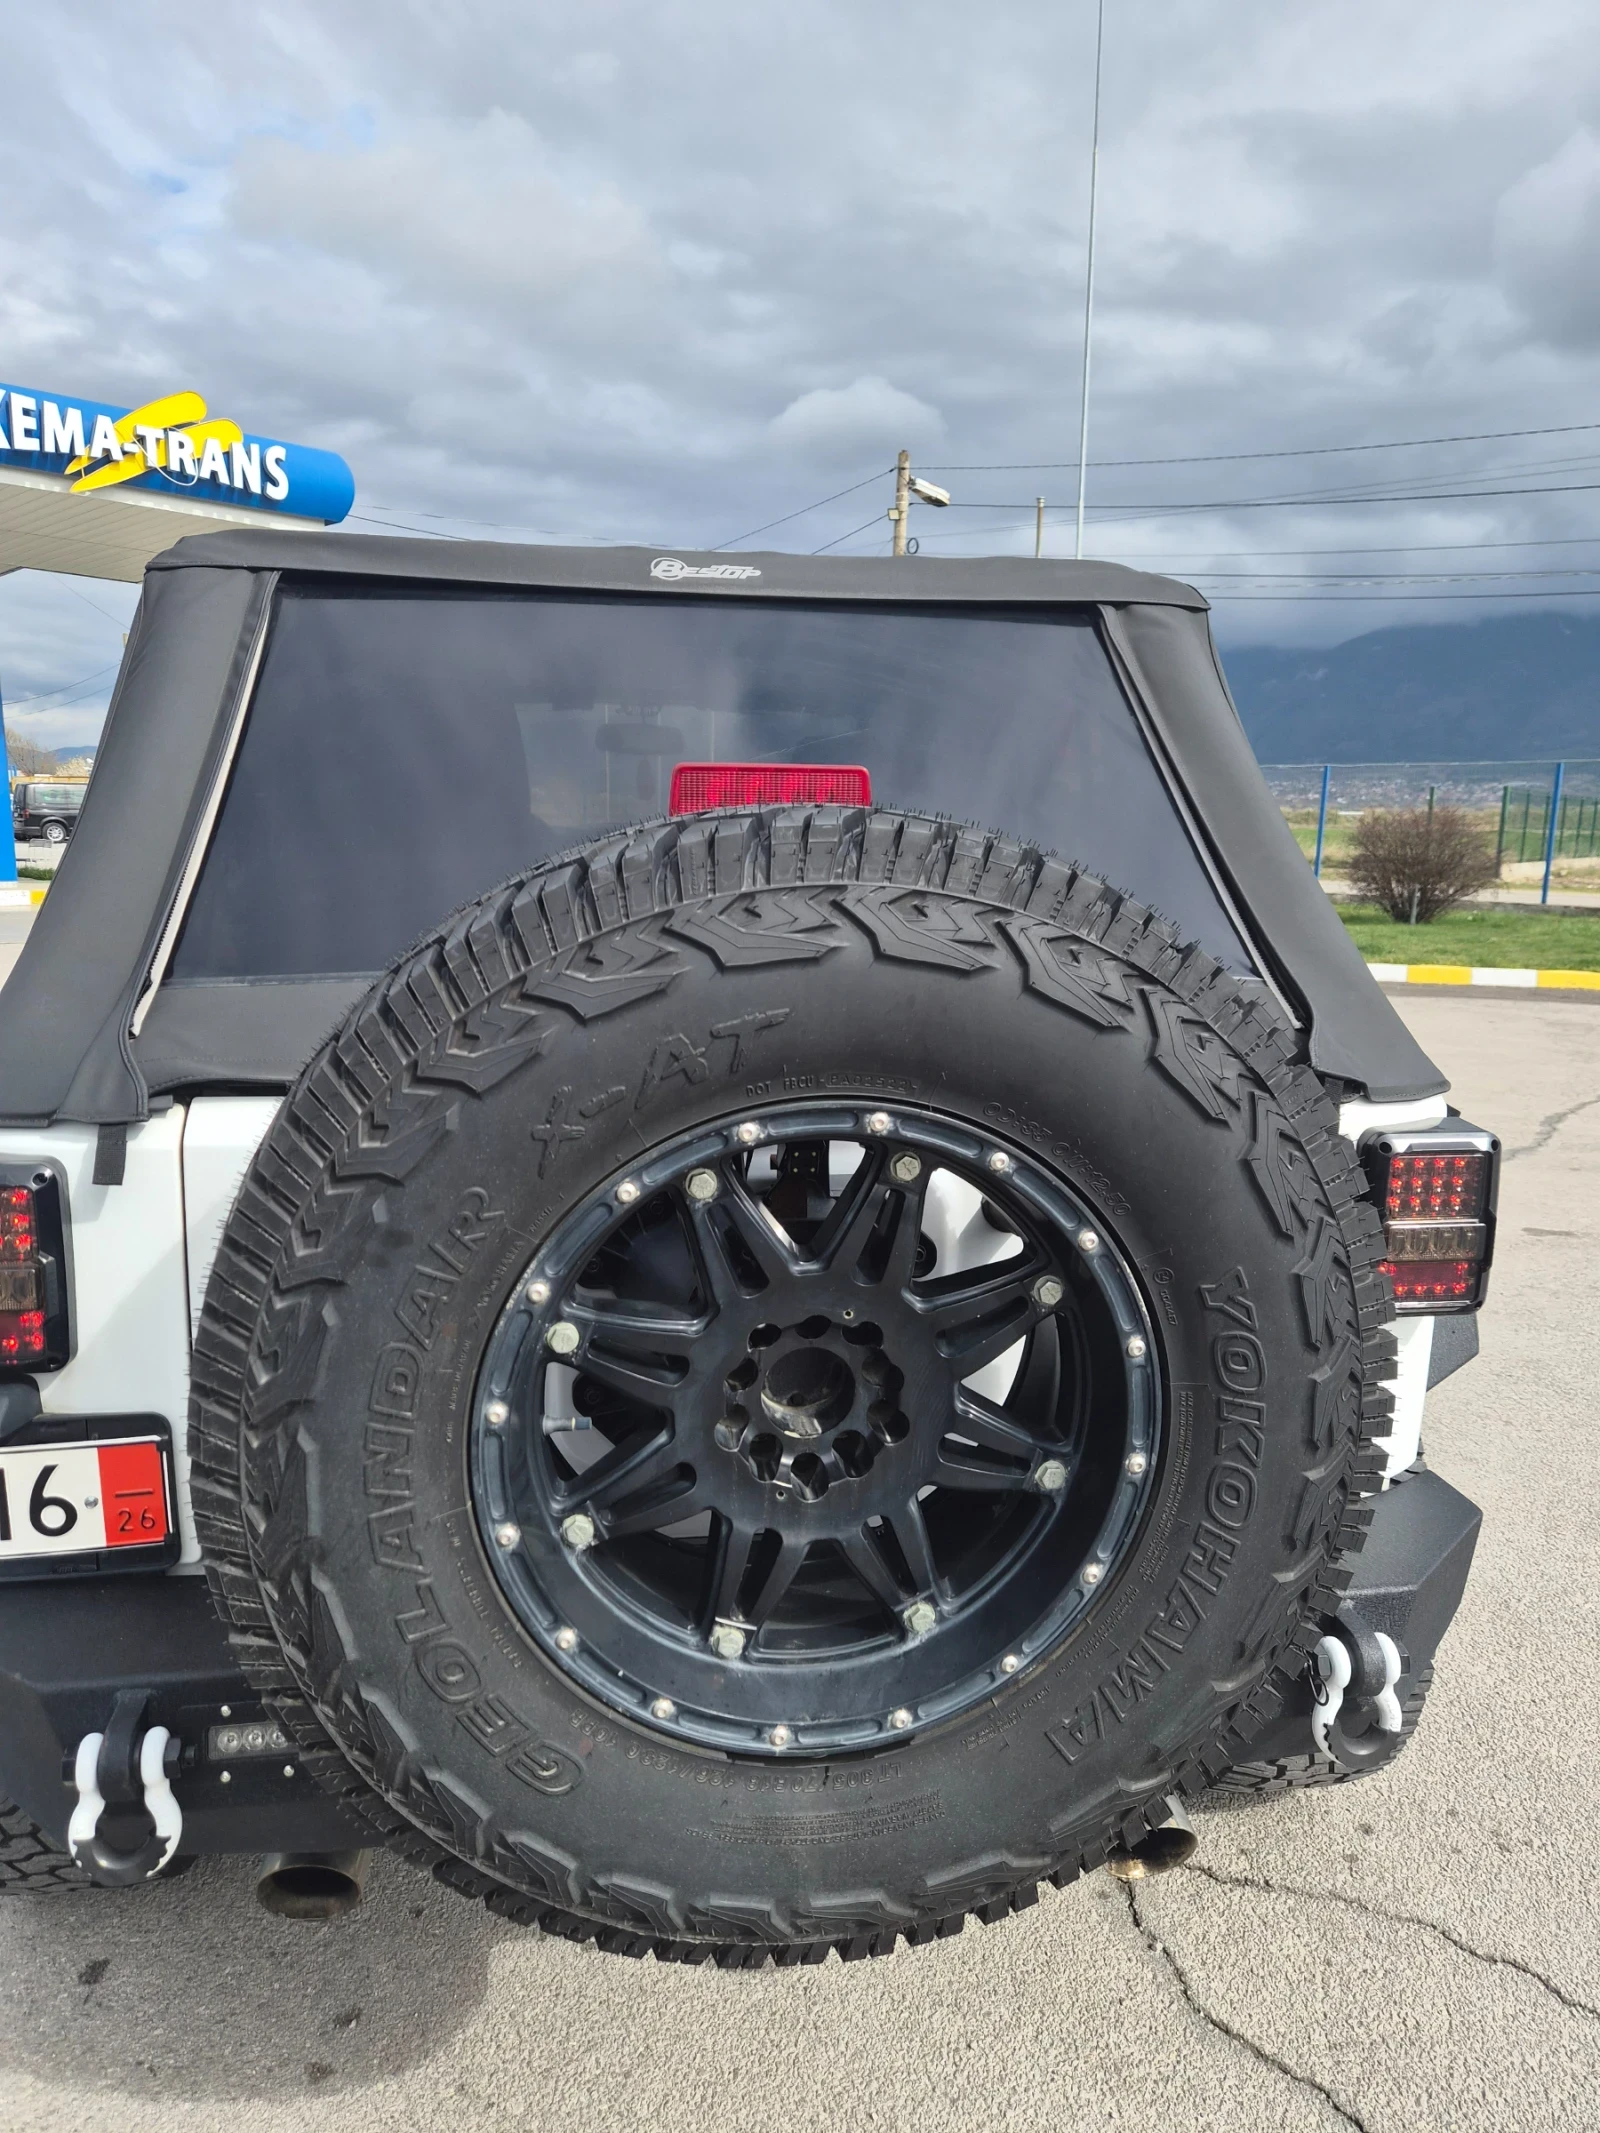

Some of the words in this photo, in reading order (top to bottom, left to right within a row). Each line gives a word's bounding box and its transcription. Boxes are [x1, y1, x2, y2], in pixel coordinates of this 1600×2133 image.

[118, 1506, 156, 1532] 26
[363, 1186, 586, 1796] GEOLANDAR
[1047, 1266, 1270, 1766] YOKOHAMA
